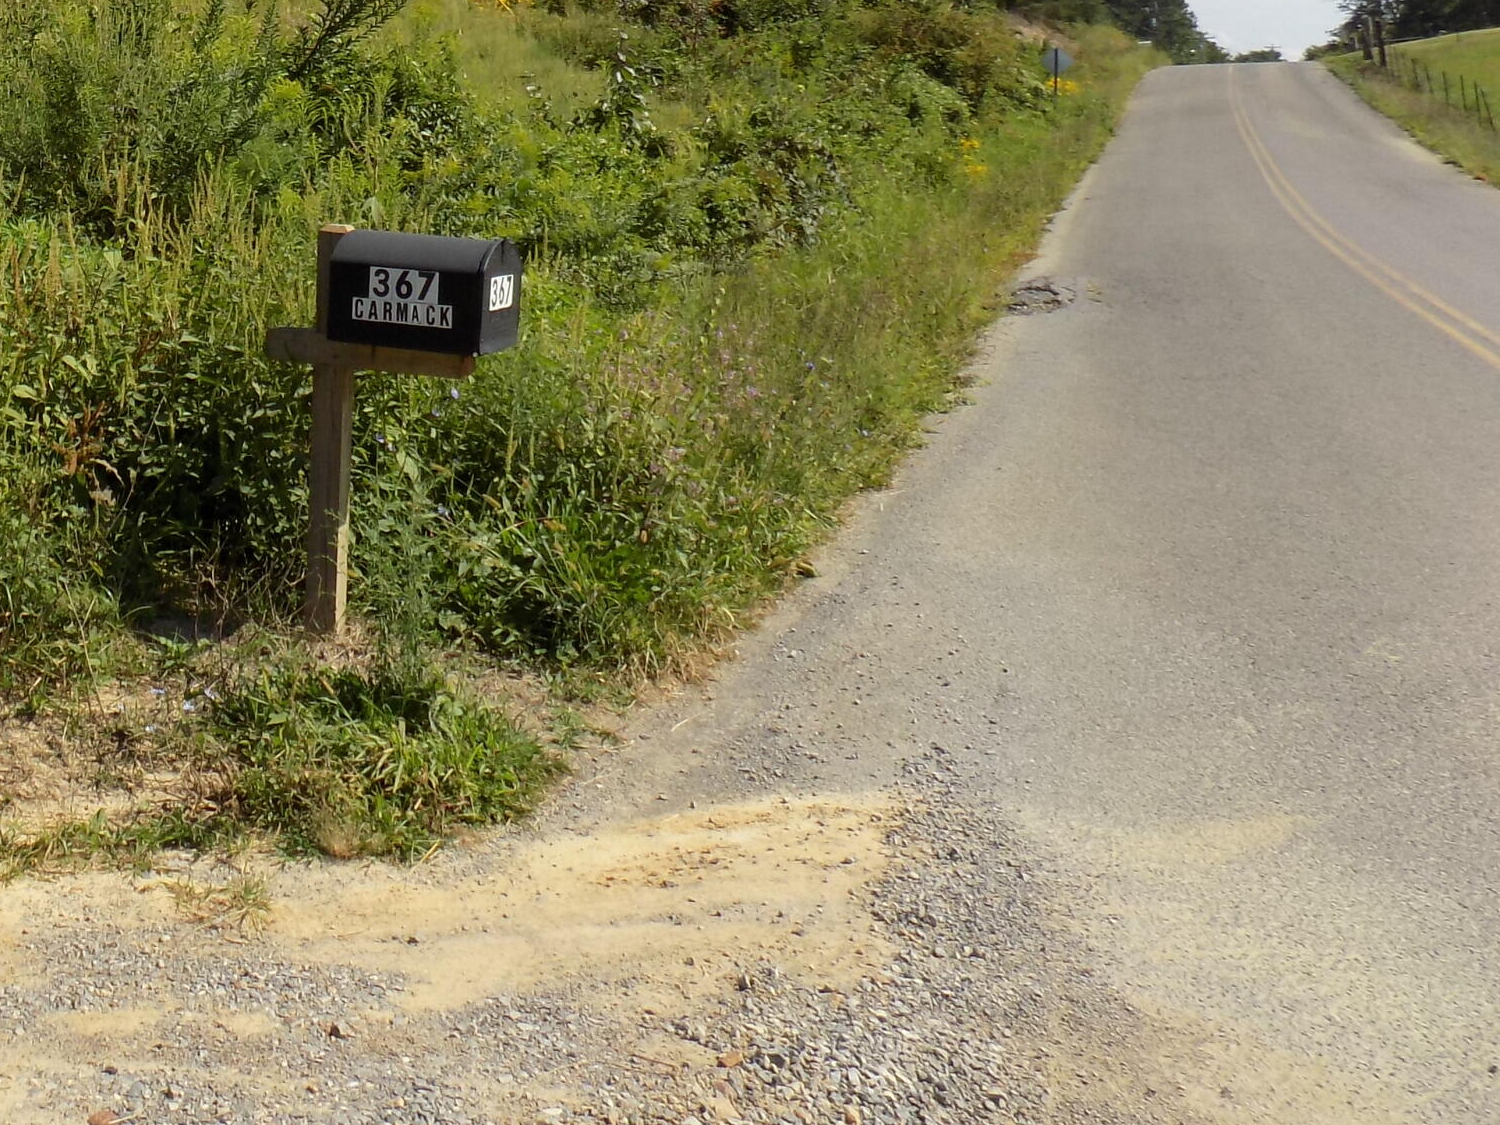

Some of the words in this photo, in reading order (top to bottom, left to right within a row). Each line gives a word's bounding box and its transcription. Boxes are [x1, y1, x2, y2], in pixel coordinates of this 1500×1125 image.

[372, 269, 437, 300] 367
[491, 277, 512, 307] 367
[354, 299, 451, 327] CARMACK
